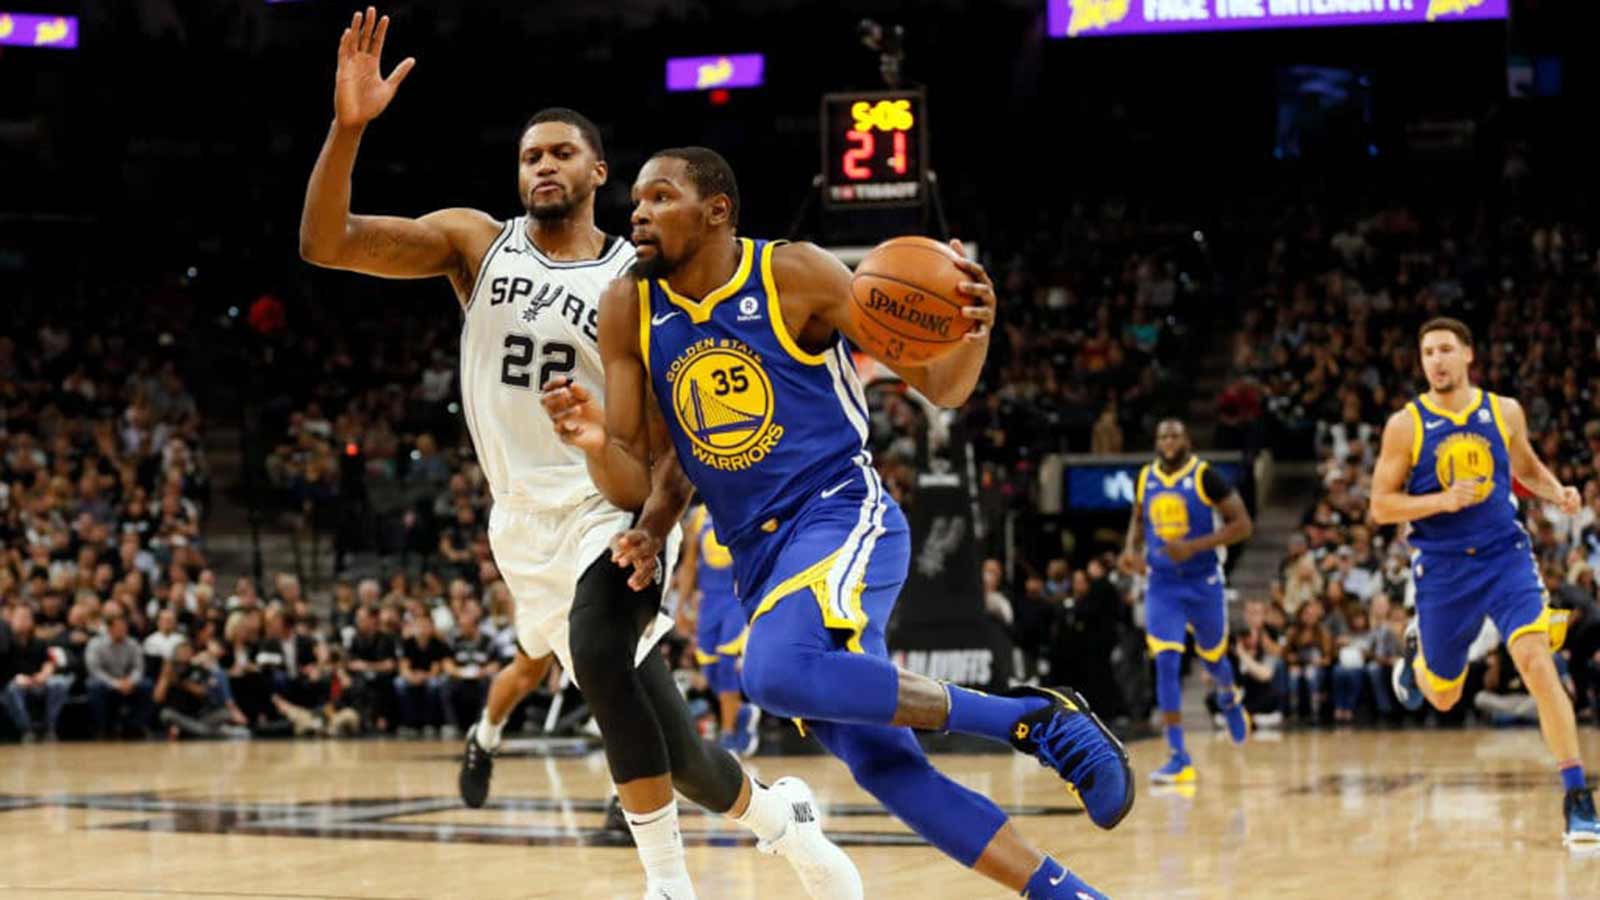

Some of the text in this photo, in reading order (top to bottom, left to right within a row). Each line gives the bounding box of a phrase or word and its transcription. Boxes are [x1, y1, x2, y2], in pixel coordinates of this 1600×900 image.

[842, 129, 907, 179] 21
[865, 287, 954, 337] SPALDING
[501, 334, 576, 391] 22
[666, 337, 715, 383] GOLDEN
[710, 365, 750, 396] 35
[691, 422, 785, 472] WARRIORS
